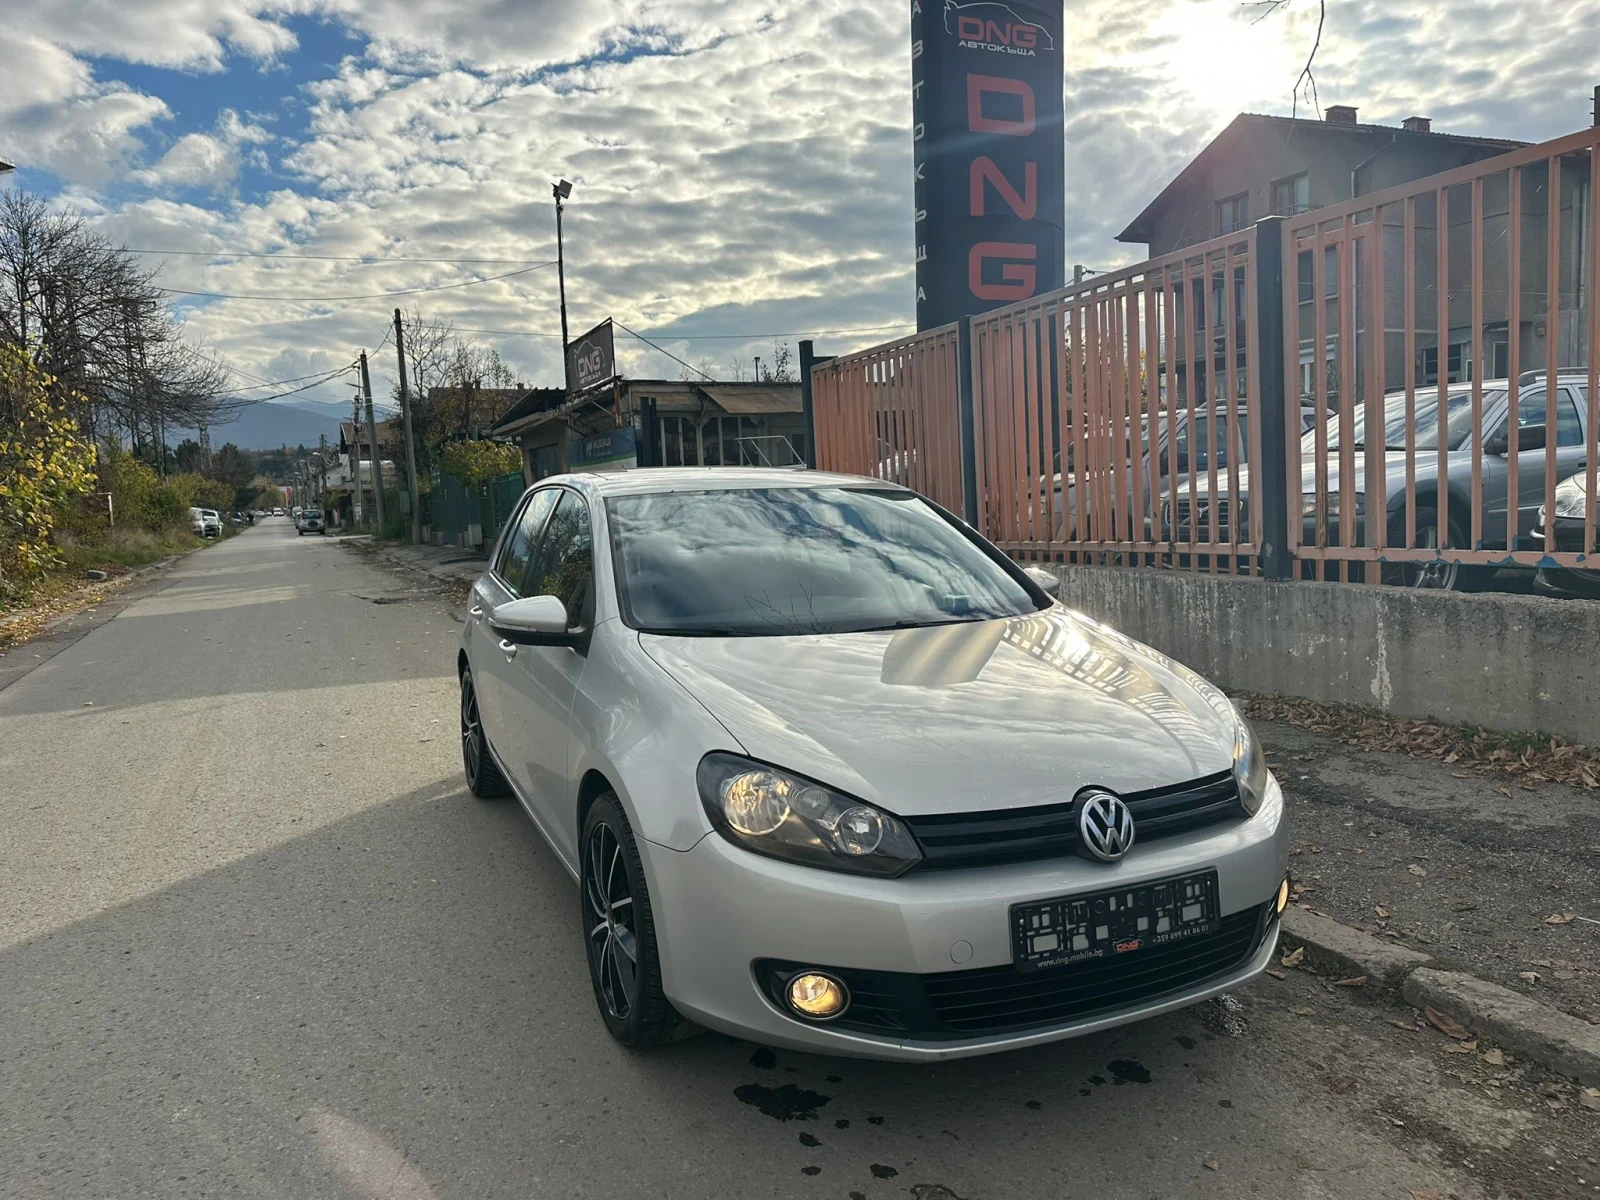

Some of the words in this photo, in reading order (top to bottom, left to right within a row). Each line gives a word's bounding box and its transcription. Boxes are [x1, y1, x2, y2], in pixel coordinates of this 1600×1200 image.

[957, 16, 1038, 49] DNG
[958, 40, 1036, 57] АВТОКЪЩА
[967, 73, 1037, 301] DNG
[578, 350, 600, 378] DNG
[1152, 934, 1169, 944] +359
[1170, 930, 1182, 940] 899
[1183, 928, 1191, 937] 41
[1192, 926, 1201, 935] 06
[1201, 924, 1209, 933] 01
[1036, 948, 1104, 969] www.dng.mobile.bg
